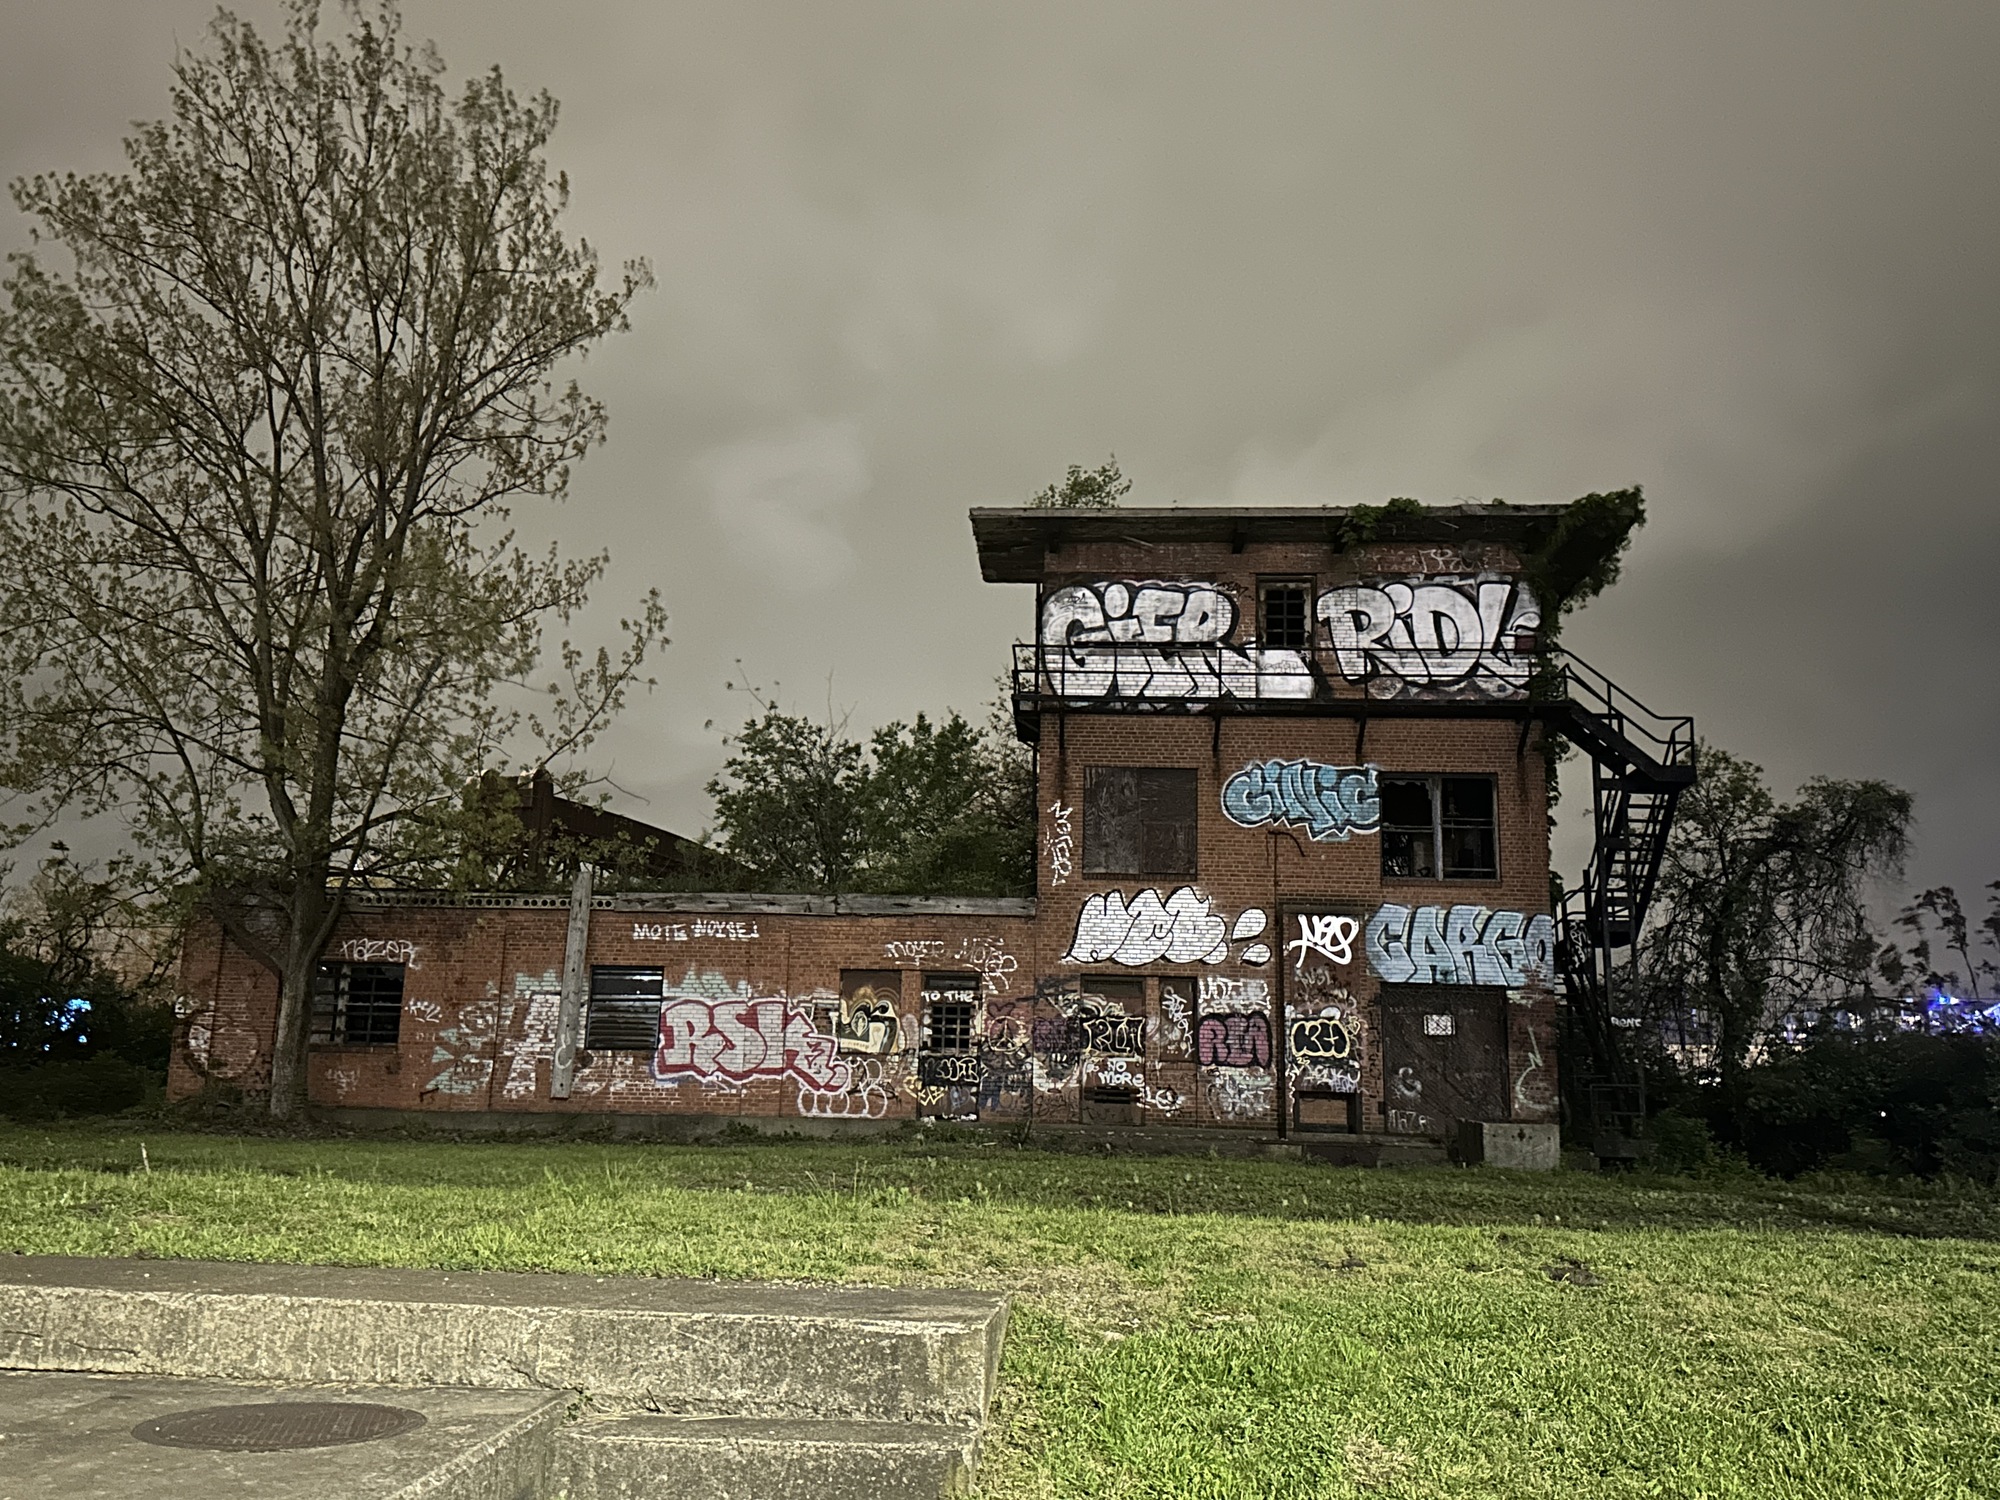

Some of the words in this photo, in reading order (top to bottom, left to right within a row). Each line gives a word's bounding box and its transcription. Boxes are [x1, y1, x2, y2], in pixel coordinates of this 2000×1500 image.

[1365, 902, 1554, 993] CARGO
[921, 990, 941, 1002] TO
[1107, 1061, 1127, 1073] NO
